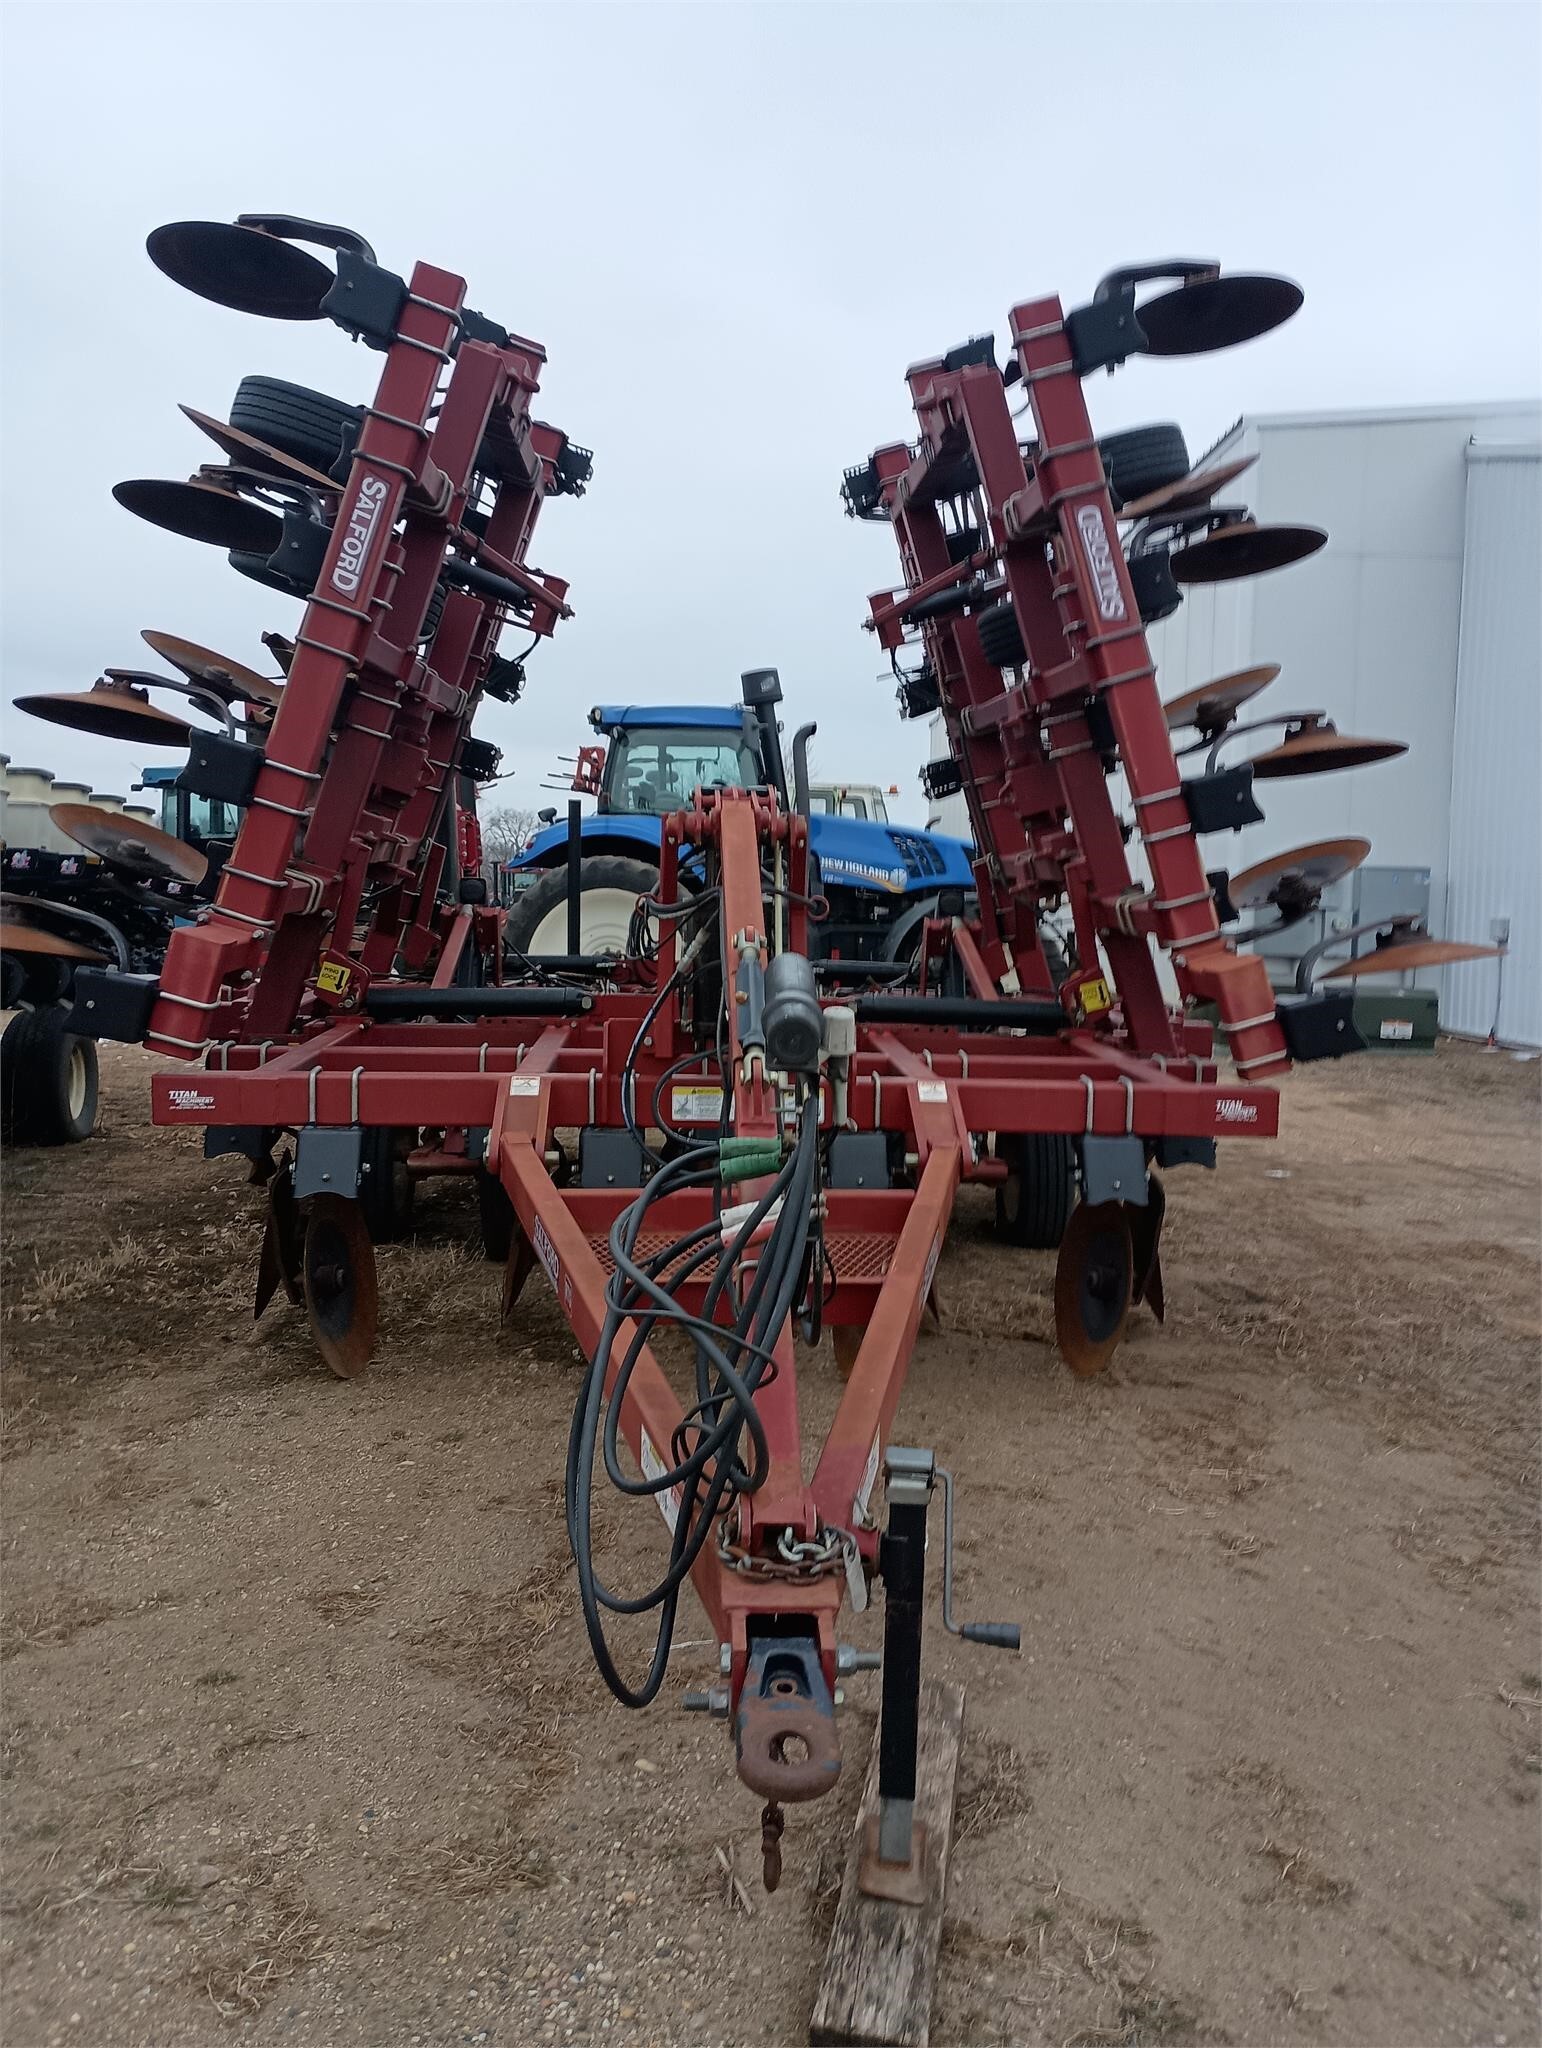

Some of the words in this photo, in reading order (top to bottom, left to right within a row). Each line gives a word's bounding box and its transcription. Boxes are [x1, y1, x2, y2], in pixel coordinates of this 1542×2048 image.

[331, 476, 387, 591] SALFORD
[820, 856, 844, 870] NEW
[845, 860, 889, 881] HOLLAND
[168, 1090, 198, 1099] TITAN
